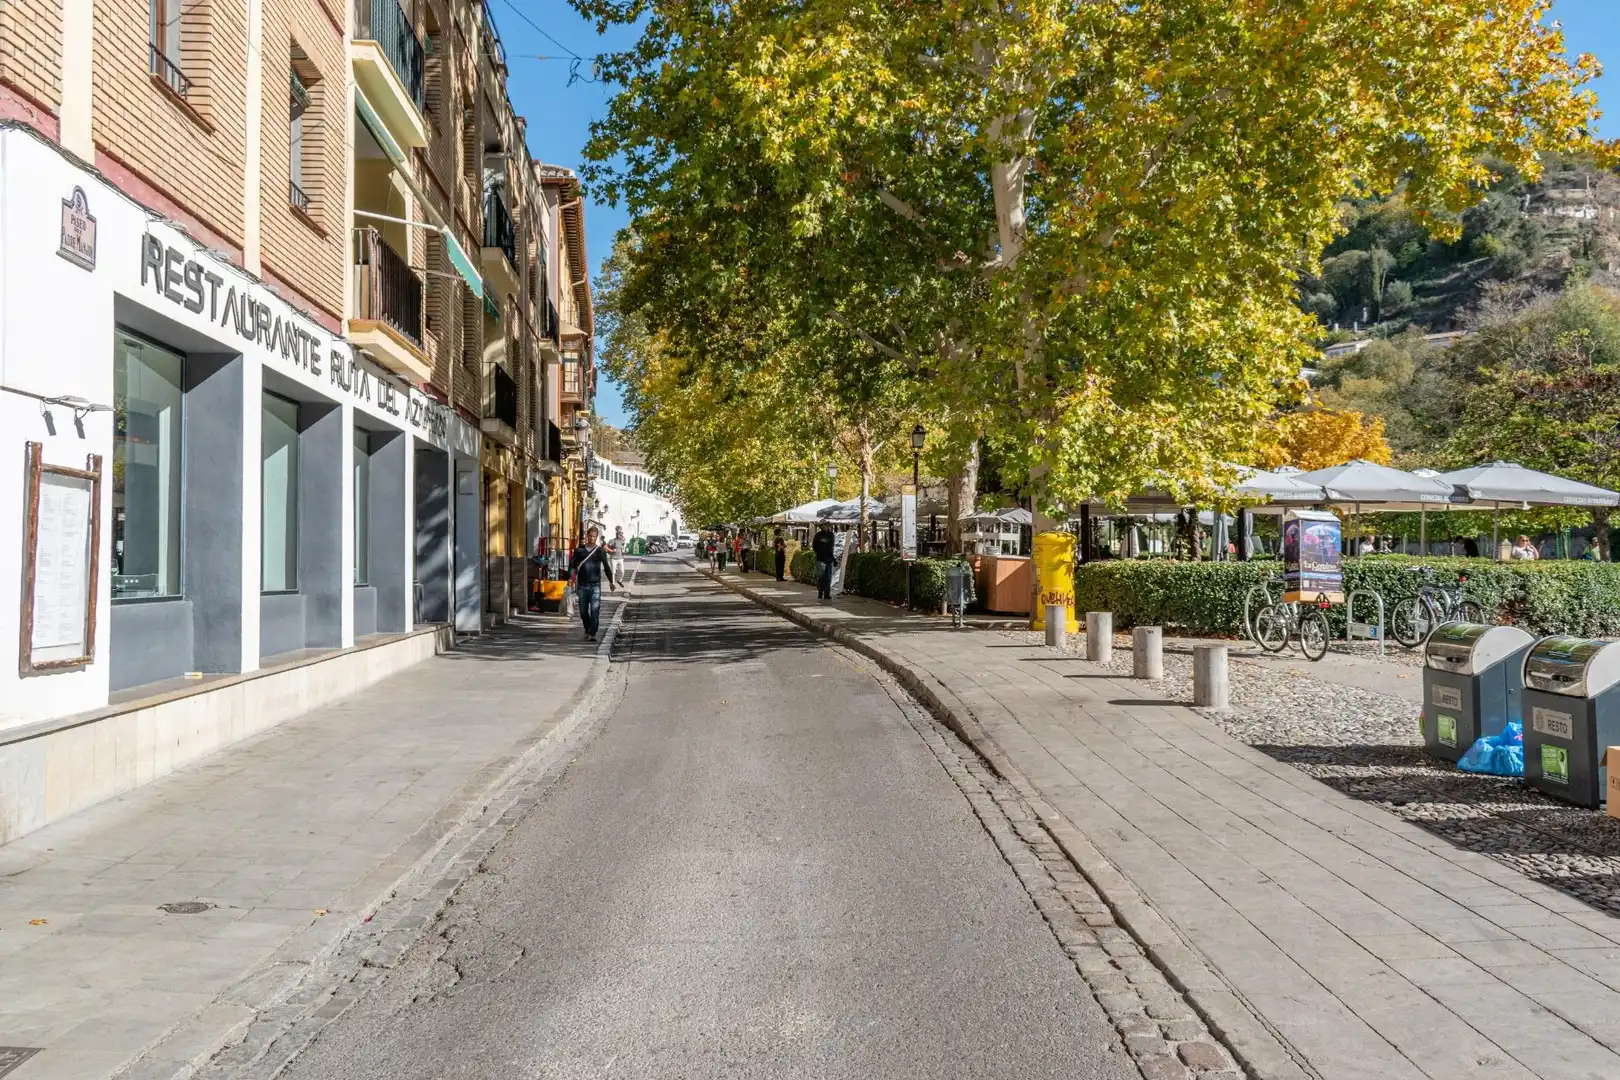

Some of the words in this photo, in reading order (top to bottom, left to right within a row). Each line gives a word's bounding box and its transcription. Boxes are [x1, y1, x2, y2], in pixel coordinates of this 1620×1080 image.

[141, 231, 322, 377] RESTAURANTE
[331, 350, 371, 403] RUTA
[378, 377, 400, 416] DEL
[1547, 720, 1568, 734] RESTO
